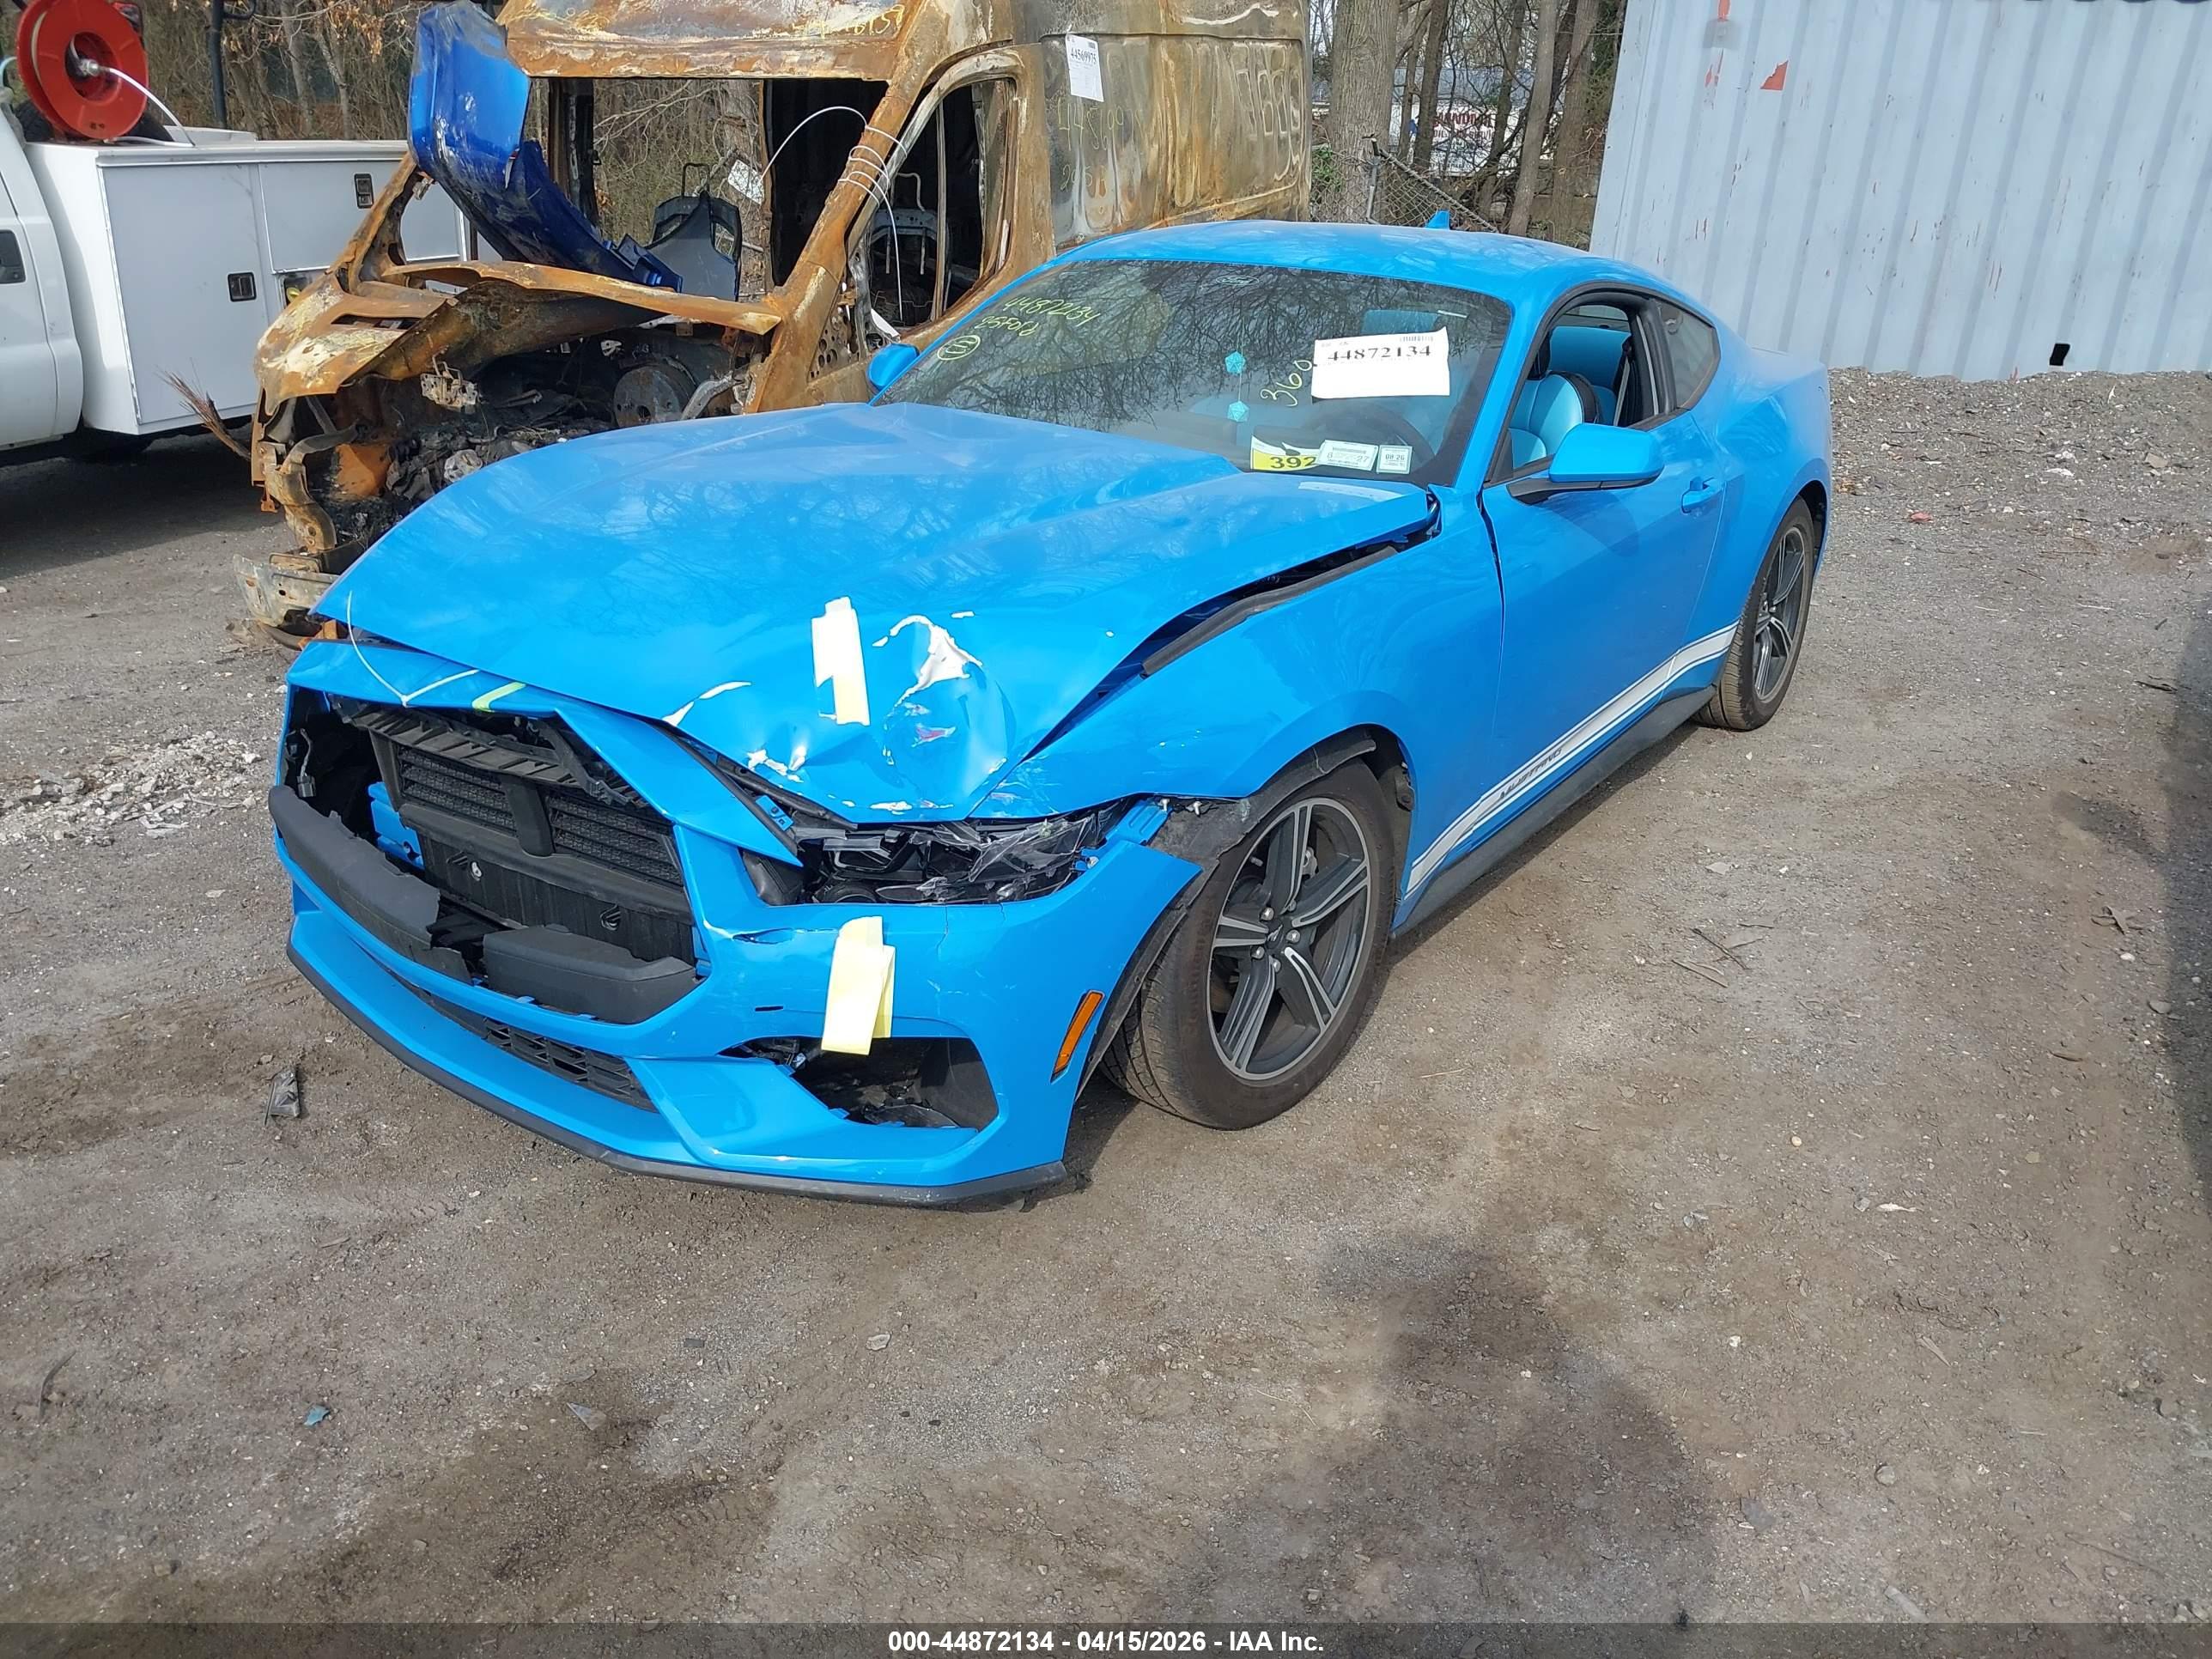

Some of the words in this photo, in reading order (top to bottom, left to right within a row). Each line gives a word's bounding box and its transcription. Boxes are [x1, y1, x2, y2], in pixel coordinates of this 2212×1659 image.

[1328, 344, 1431, 362] 44872134
[1260, 359, 1313, 407] 360
[1270, 455, 1317, 469] 392
